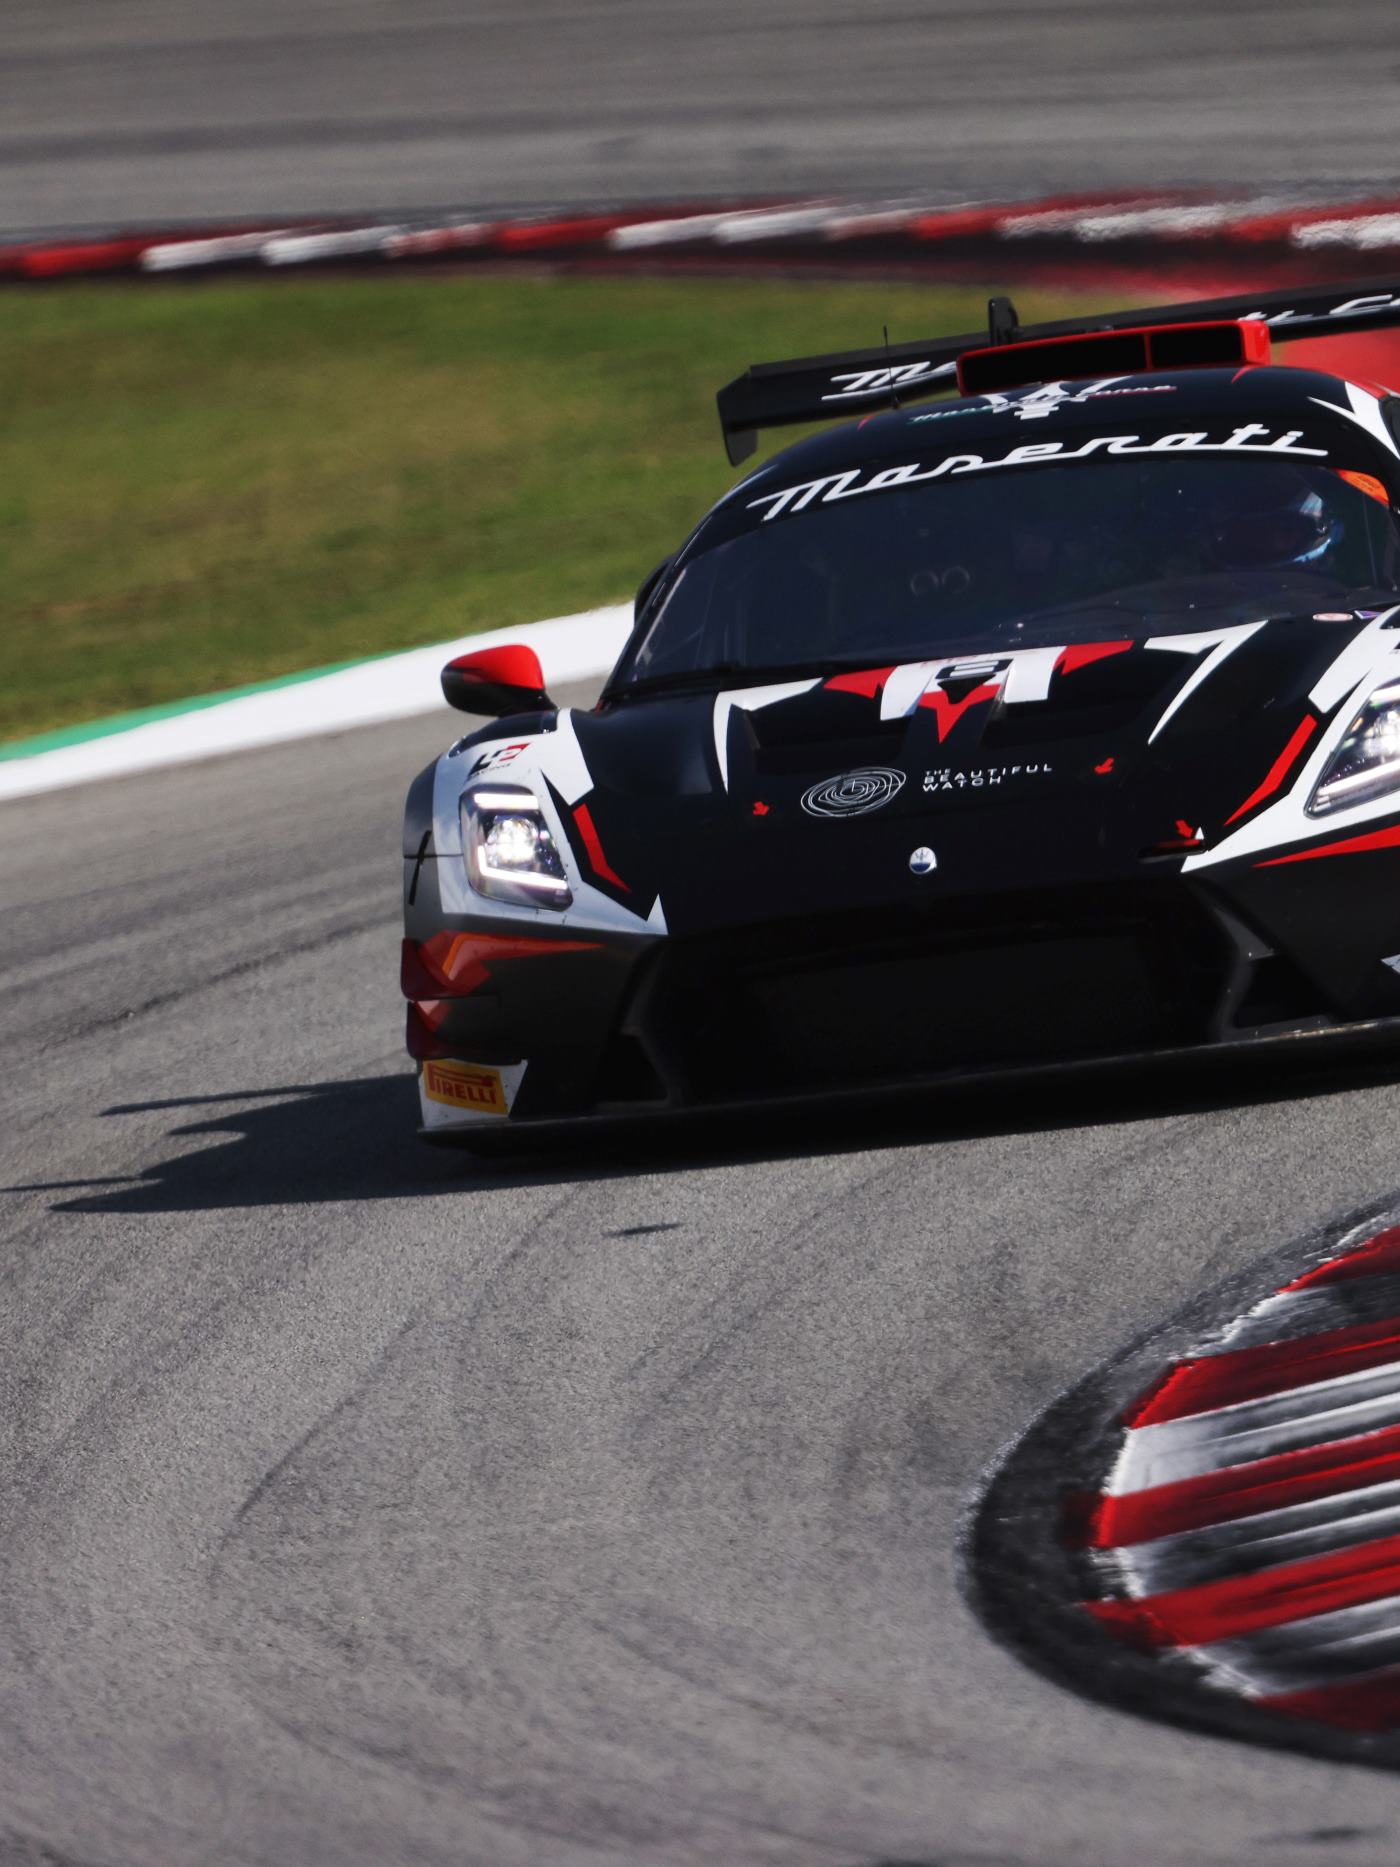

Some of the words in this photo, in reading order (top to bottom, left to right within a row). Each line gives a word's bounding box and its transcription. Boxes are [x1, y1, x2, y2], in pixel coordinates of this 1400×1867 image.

[746, 423, 1329, 522] Maserati
[923, 763, 1054, 785] BEAUTIFUL
[924, 768, 952, 776] THE
[922, 776, 1002, 793] WATCH
[427, 1062, 497, 1106] PIRELLI
